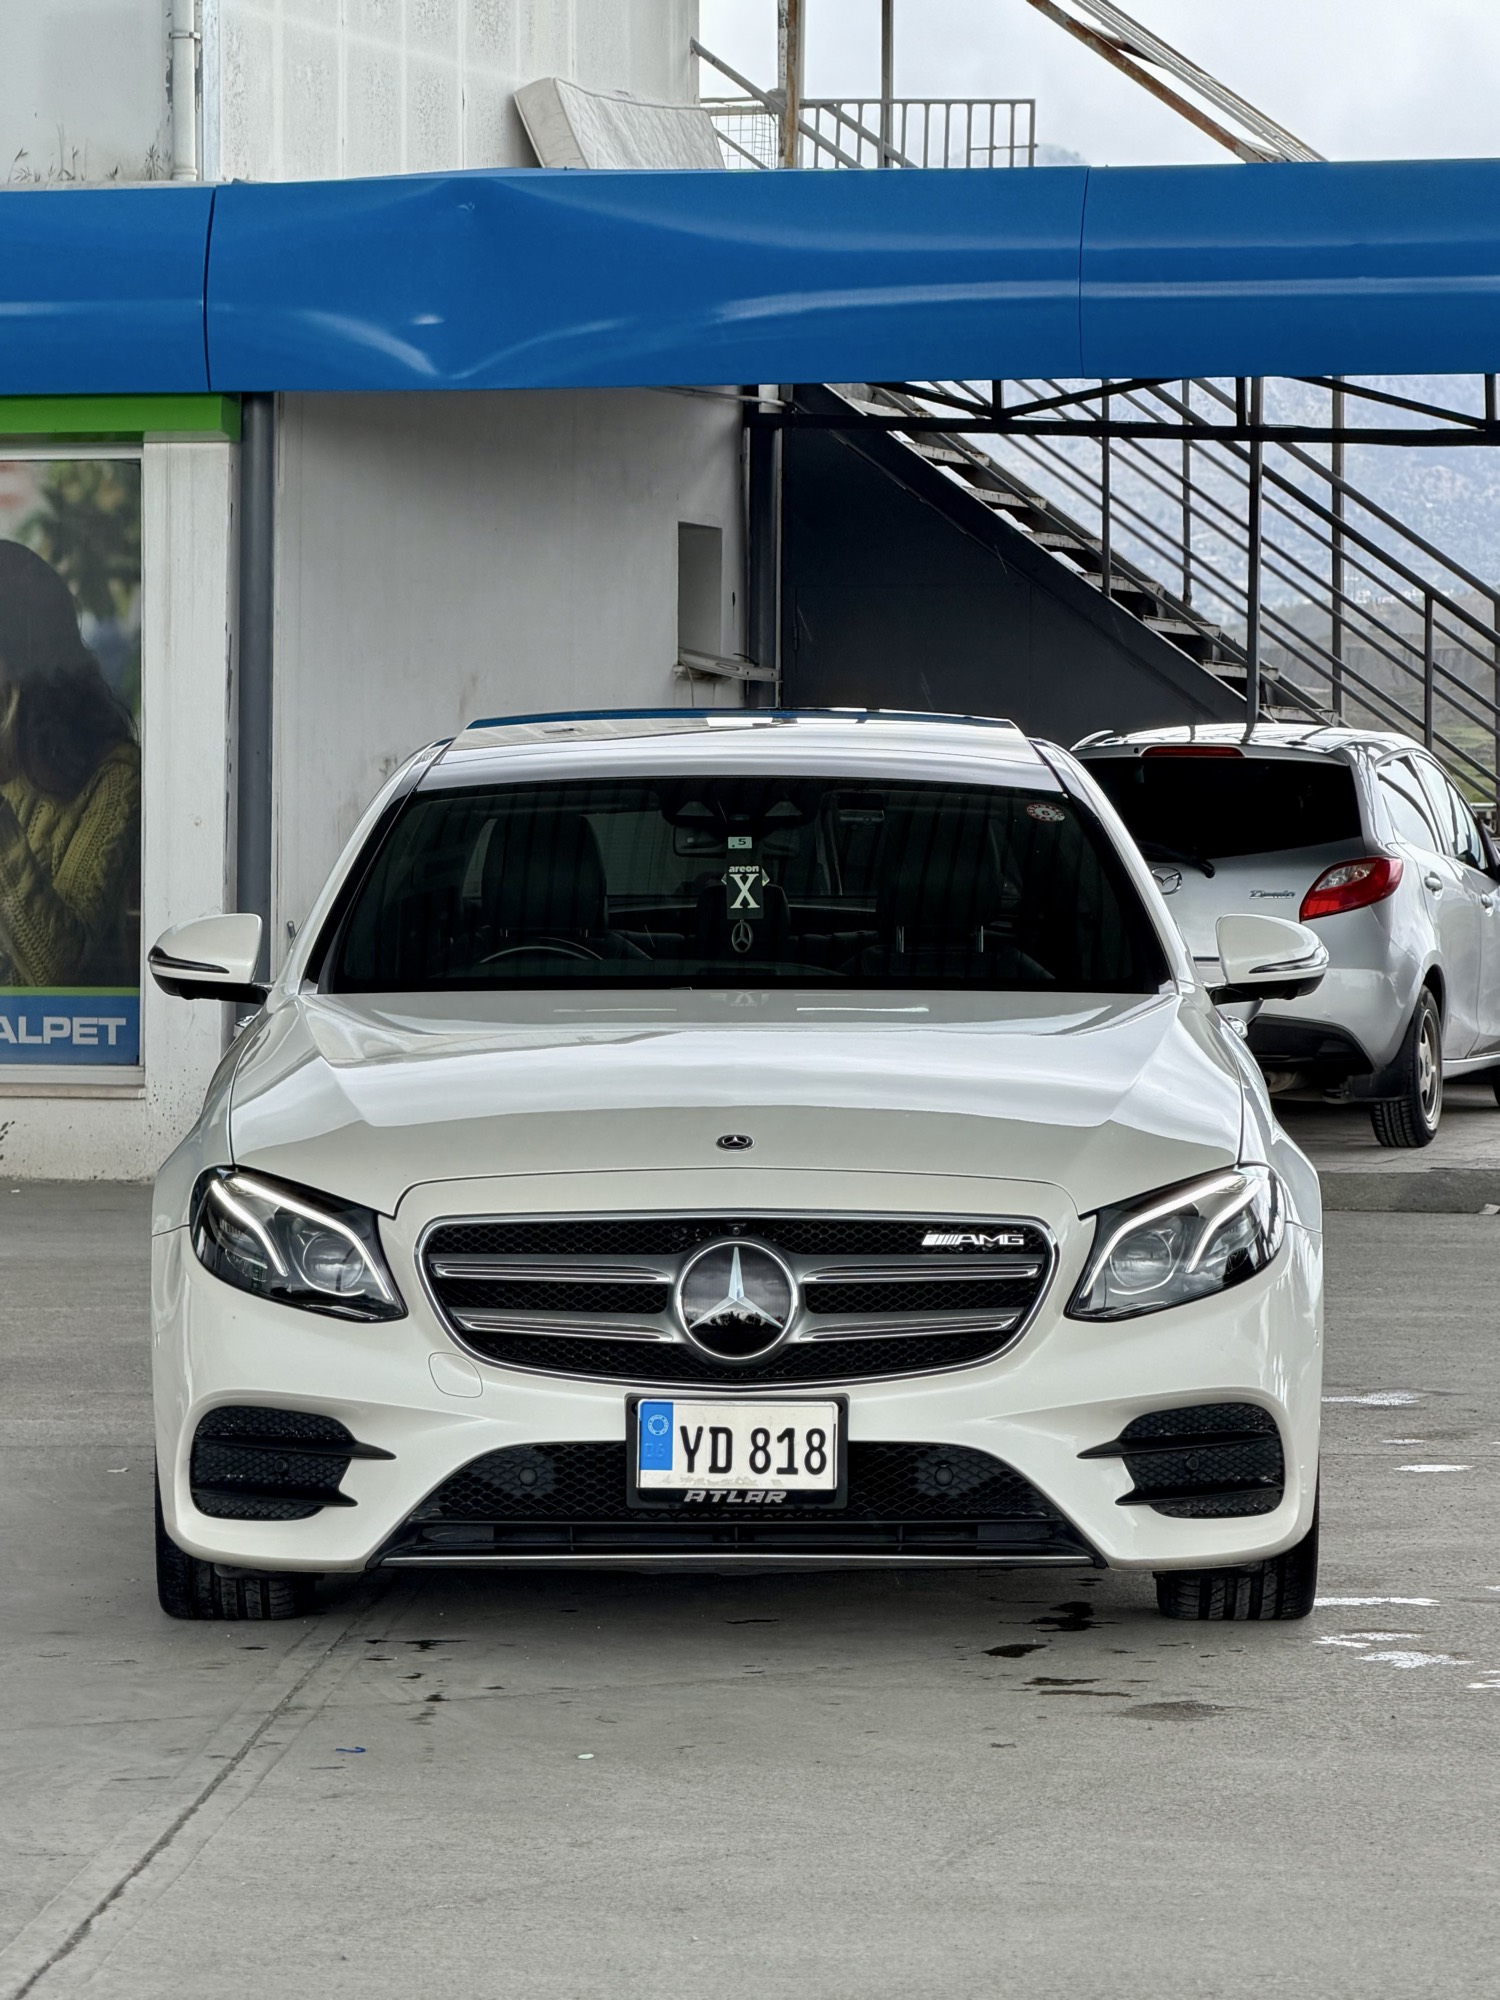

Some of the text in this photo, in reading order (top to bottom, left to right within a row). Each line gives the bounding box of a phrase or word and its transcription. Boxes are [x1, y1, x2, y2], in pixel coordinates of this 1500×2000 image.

[728, 865, 760, 873] areon
[729, 873, 761, 909] X
[956, 1233, 1025, 1246] AMG
[679, 1425, 827, 1476] YD 818
[683, 1489, 788, 1504] ATLAR
